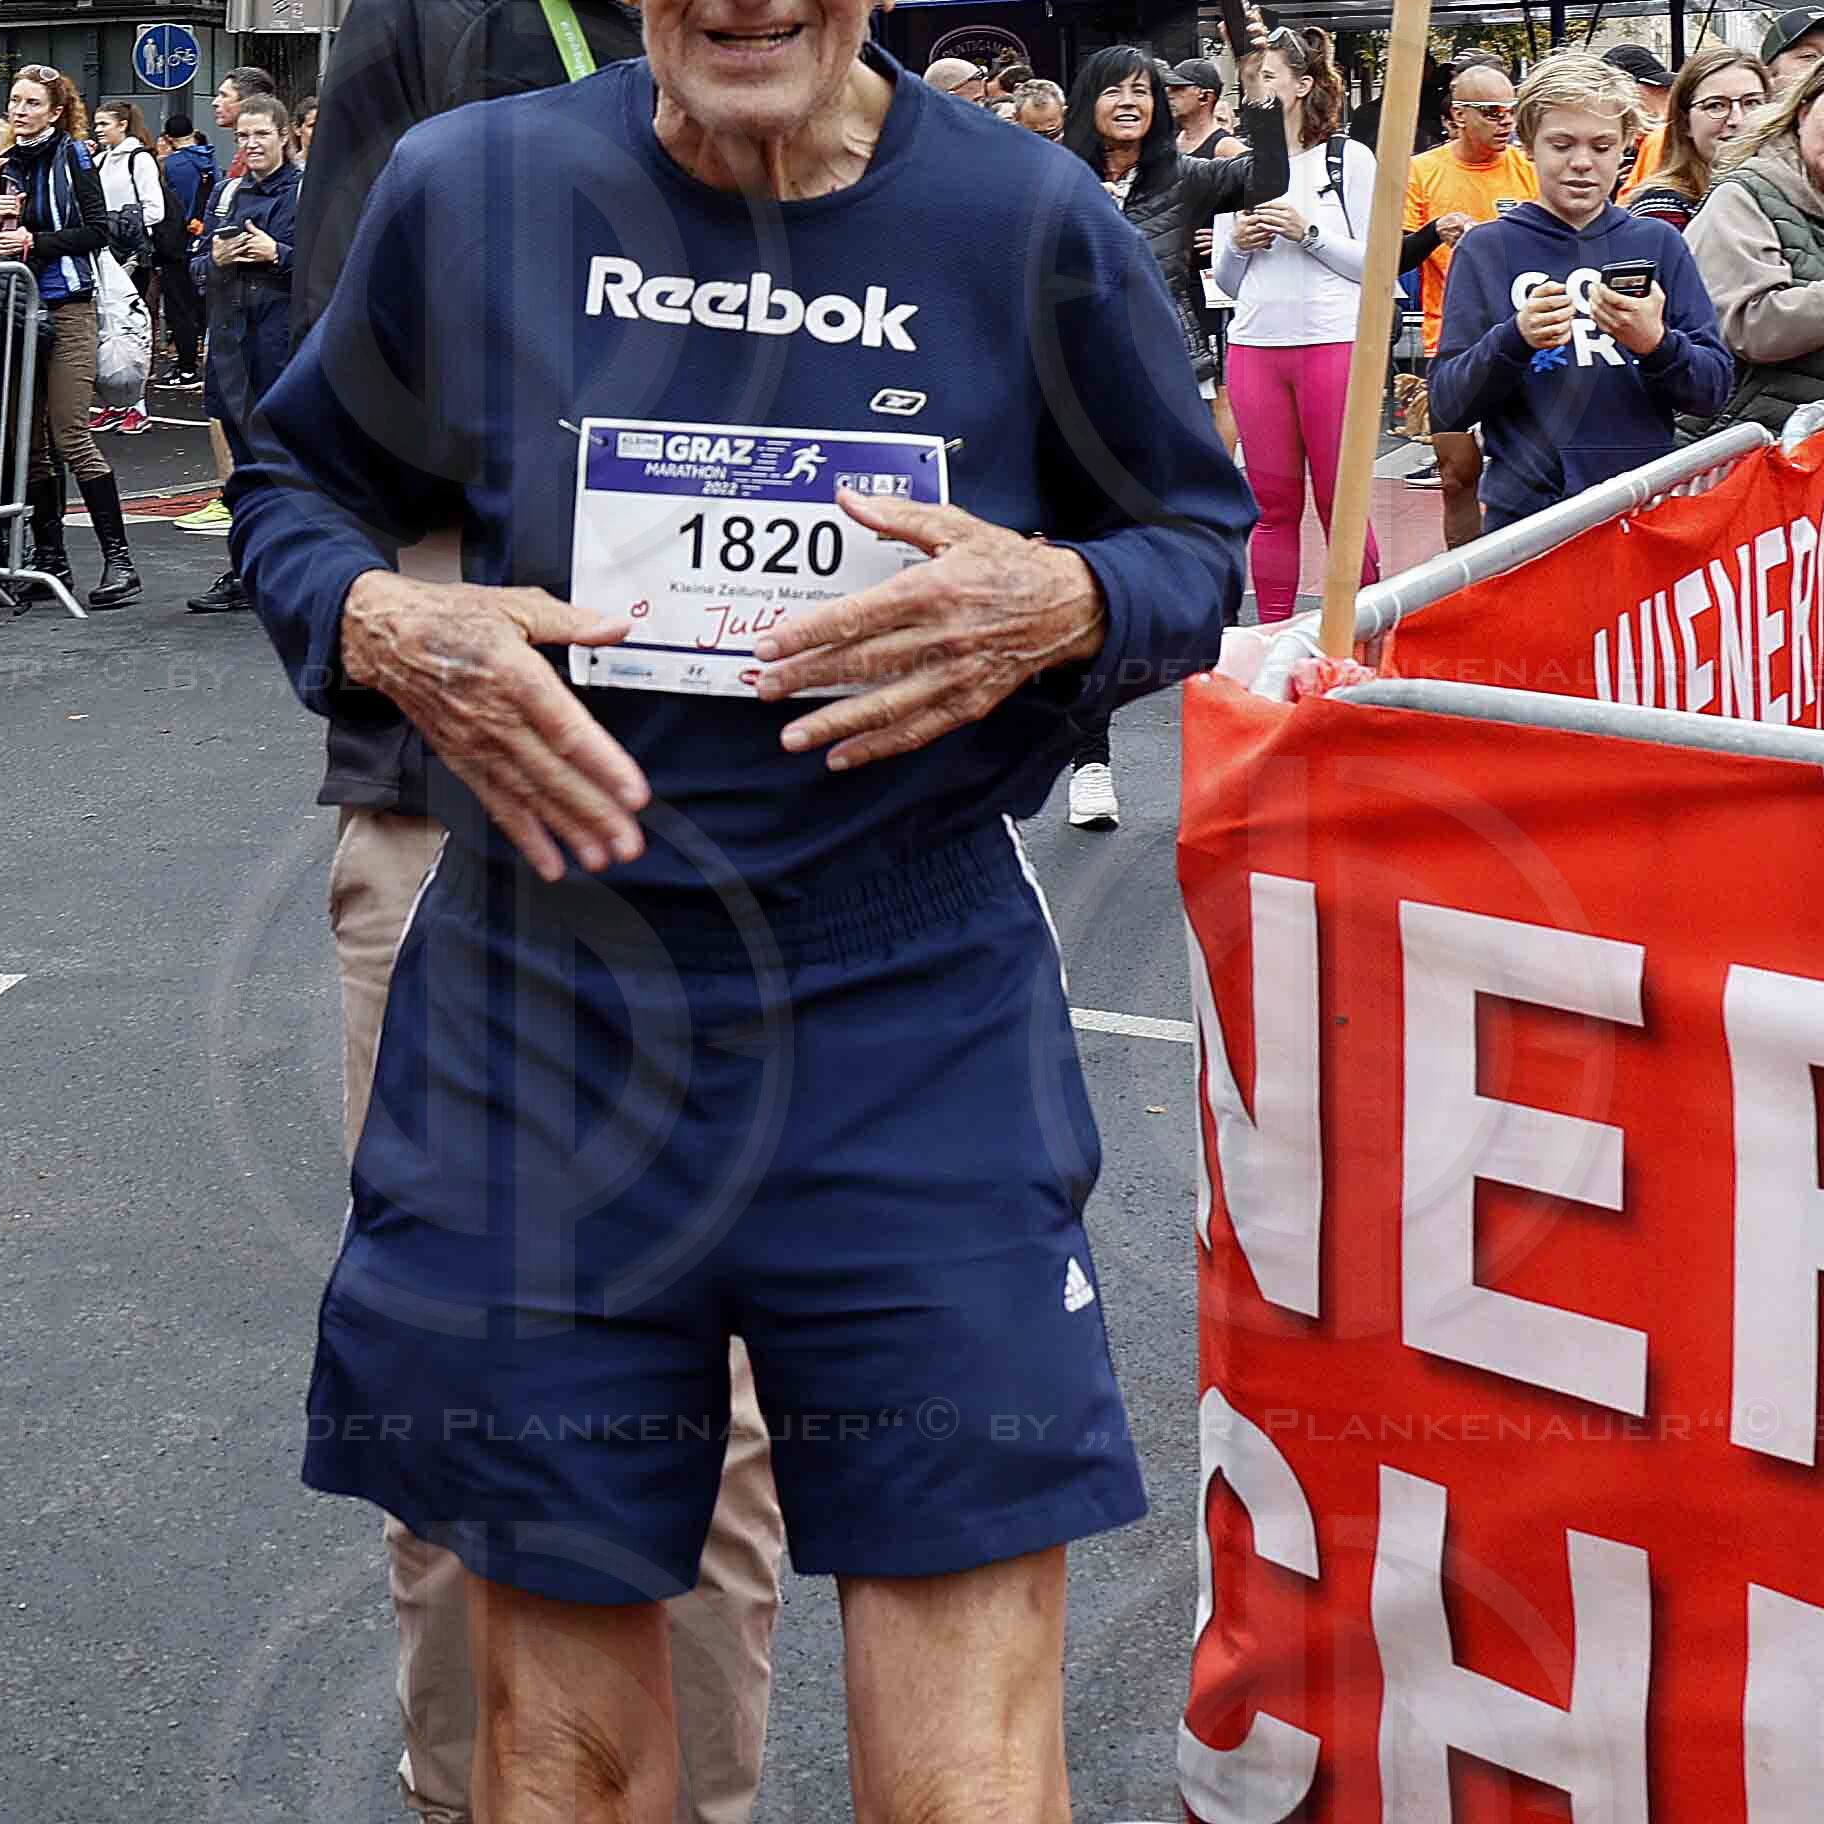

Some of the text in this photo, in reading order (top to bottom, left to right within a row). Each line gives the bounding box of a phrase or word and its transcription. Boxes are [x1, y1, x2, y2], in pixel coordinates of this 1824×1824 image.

[585, 255, 921, 352] Reebok
[665, 435, 756, 466] GRAZ
[644, 462, 727, 479] MARATHON
[679, 513, 844, 577] 1820
[669, 582, 714, 597] Kleine
